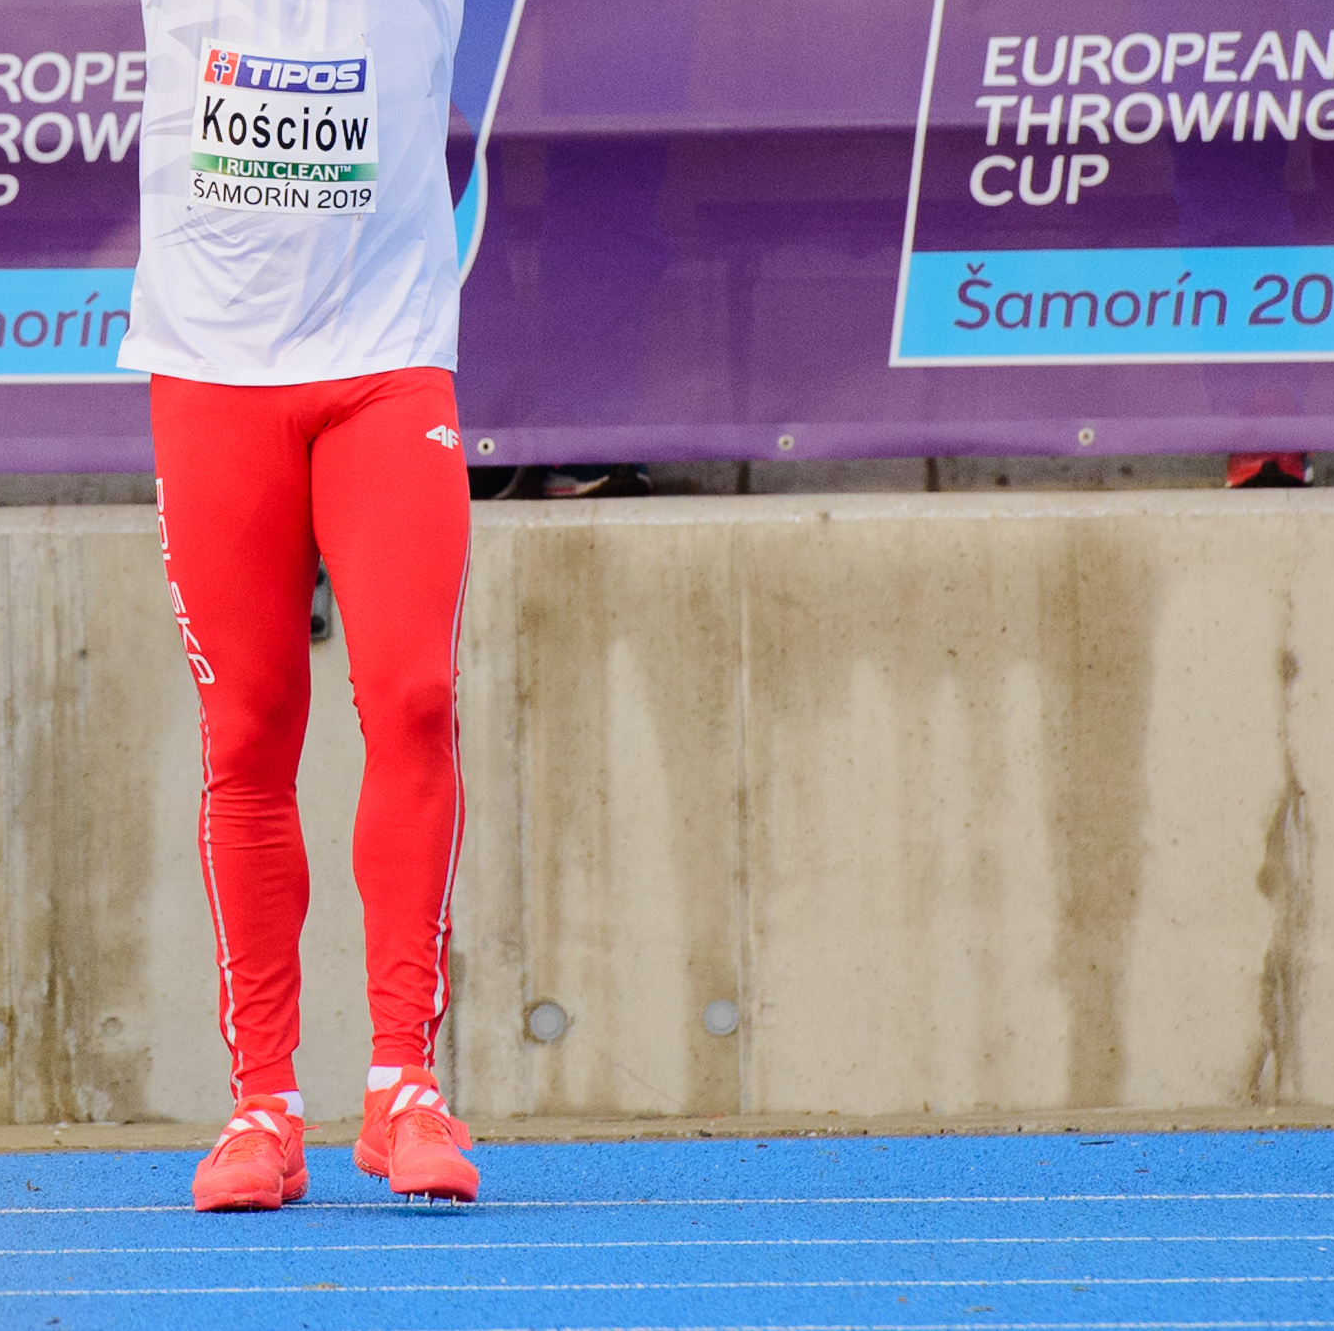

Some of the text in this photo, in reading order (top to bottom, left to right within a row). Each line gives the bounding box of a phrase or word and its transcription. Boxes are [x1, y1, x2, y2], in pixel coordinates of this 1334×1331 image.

[246, 60, 361, 91] TIPOS
[202, 95, 369, 152] Kościów
[218, 157, 224, 173] I
[226, 158, 268, 178] RUN
[968, 153, 1110, 207] CUP
[193, 172, 372, 209] ŠAMORÍN 2019
[952, 261, 1228, 331] Šamorín
[425, 424, 459, 449] 4F
